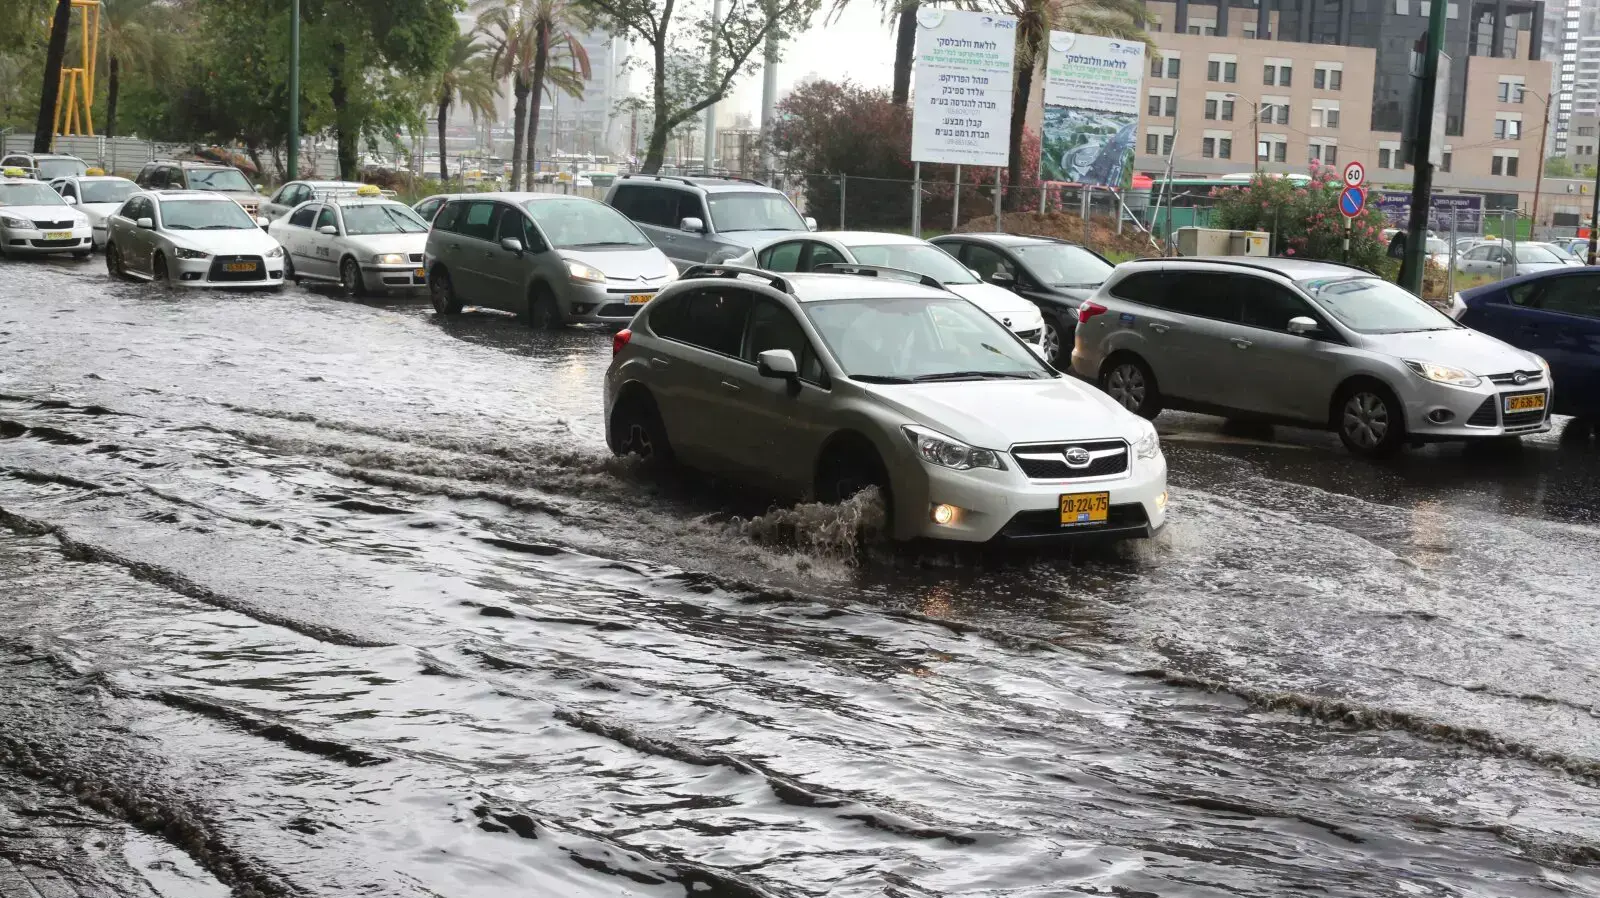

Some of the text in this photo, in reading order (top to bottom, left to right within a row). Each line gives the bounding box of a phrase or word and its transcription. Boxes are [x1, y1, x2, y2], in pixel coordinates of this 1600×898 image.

[936, 37, 997, 50] לולאת וולובלסקי
[1066, 54, 1127, 68] לולאת וולובלסקי
[971, 76, 989, 84] מנהל
[950, 98, 976, 108] להנדסה
[977, 100, 996, 109] חברה
[966, 118, 983, 128] קבלן
[1347, 169, 1360, 181] 60
[1062, 496, 1107, 513] 20-224-75
